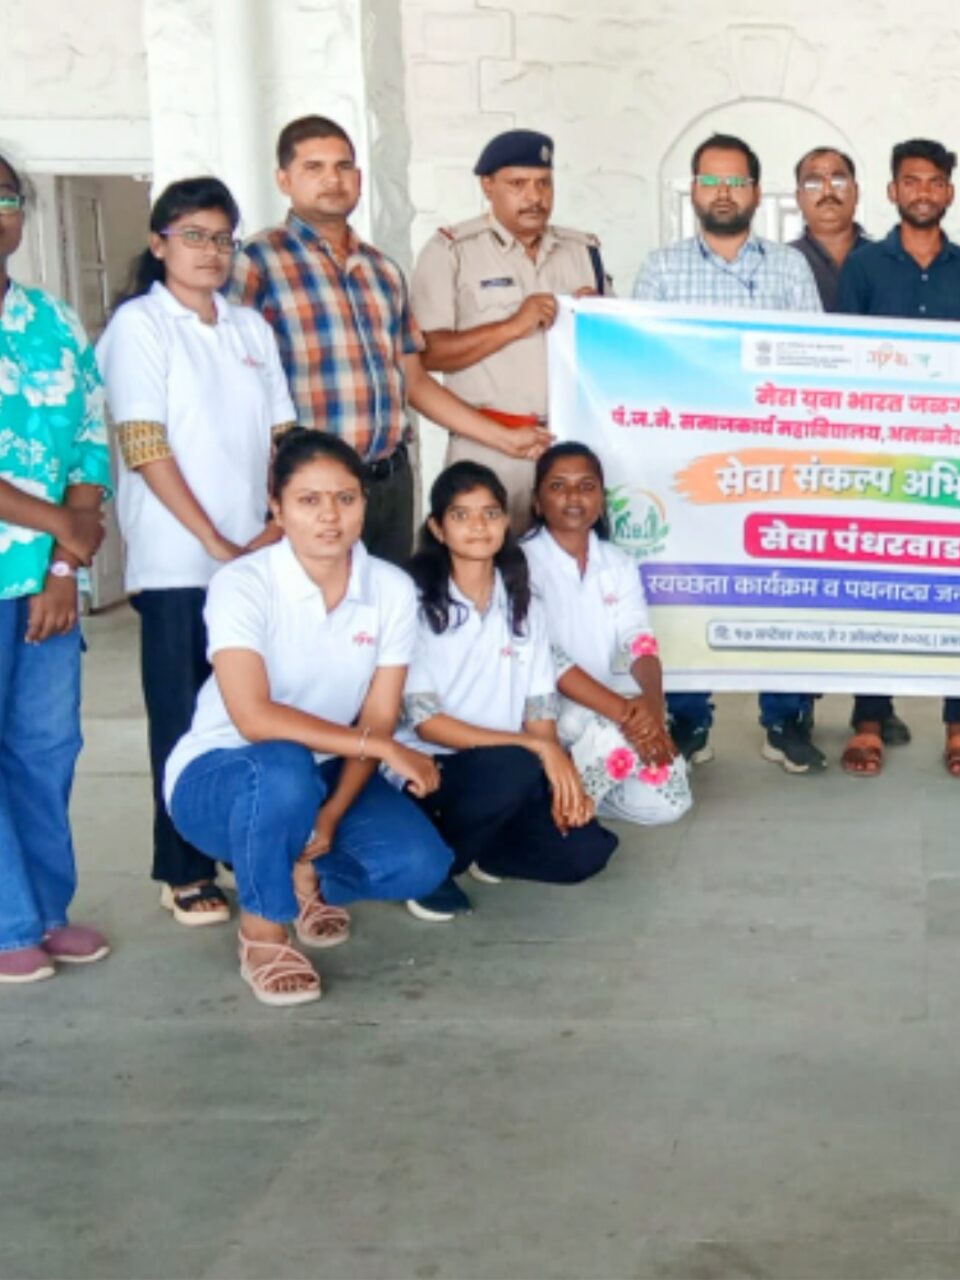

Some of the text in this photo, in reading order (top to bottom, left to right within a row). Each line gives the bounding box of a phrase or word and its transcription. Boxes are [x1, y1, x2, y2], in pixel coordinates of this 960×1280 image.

[755, 382, 796, 407] मेरा
[801, 389, 842, 415] युवा
[848, 391, 904, 412] भारत
[716, 456, 785, 496] सेवा
[793, 456, 892, 495] संकल्प
[758, 518, 827, 552] सेवा
[647, 574, 730, 596] स्वच्छता
[734, 570, 818, 597] कार्यक्रम
[823, 579, 840, 598] व
[845, 580, 931, 601] पथनाट्य
